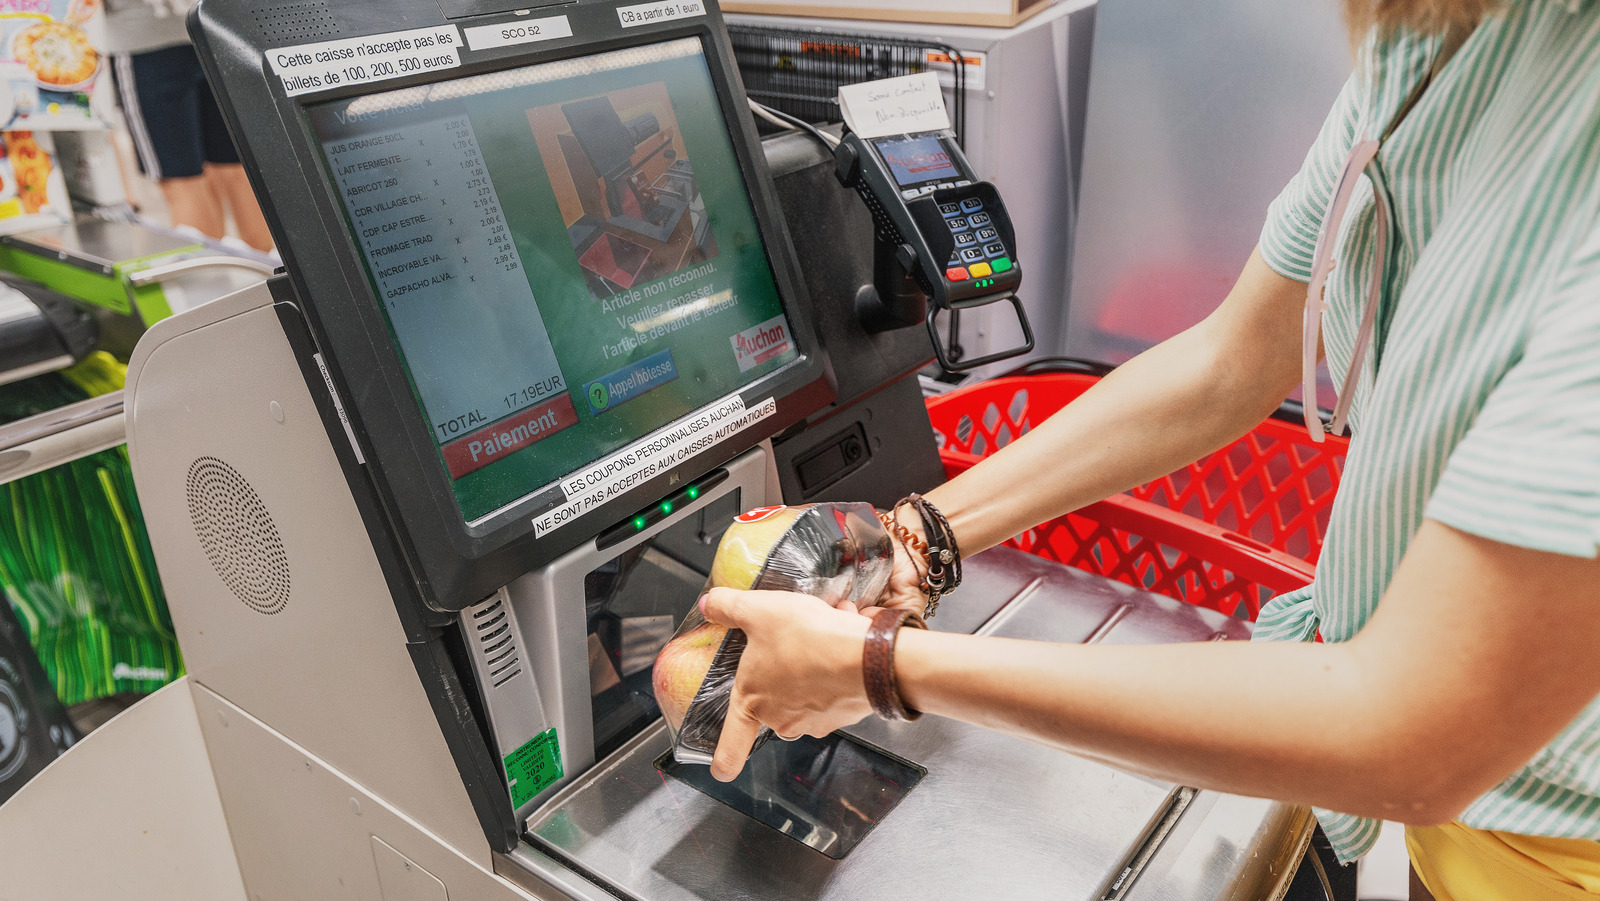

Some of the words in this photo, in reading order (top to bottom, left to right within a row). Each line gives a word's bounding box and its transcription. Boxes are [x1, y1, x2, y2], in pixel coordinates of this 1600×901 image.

[621, 11, 634, 23] CB
[635, 13, 642, 21] a
[643, 8, 663, 21] partir
[664, 6, 674, 18] de
[682, 3, 700, 14] euro
[502, 28, 526, 41] SCO
[528, 25, 541, 37] 52
[277, 49, 312, 69] Cette
[315, 45, 354, 63] caisse
[356, 38, 411, 60] n'accepte
[414, 38, 433, 53] pas
[436, 32, 453, 46] les
[284, 73, 321, 92] billets
[324, 70, 340, 85] de
[343, 65, 370, 84] 100,
[371, 62, 398, 79] 200,
[400, 58, 421, 74] 500
[423, 54, 453, 69] euros
[331, 145, 347, 155] JUS
[349, 137, 384, 151] ORANGE
[445, 121, 460, 130] 2.00
[464, 149, 476, 157] 1.79
[338, 165, 356, 176] LAIT
[358, 155, 402, 171] FERMENTE
[452, 142, 467, 150] 1.79
[471, 168, 484, 177] 1.00
[887, 152, 948, 168] Auchan
[346, 181, 384, 196] ABRICOT
[459, 161, 474, 169] 1.00
[477, 188, 490, 196] 2.73
[355, 205, 374, 217] CDR
[374, 197, 407, 212] VILLAGE
[466, 180, 481, 189] 2.73
[484, 206, 497, 215] 2.19
[943, 205, 950, 213] 2
[363, 225, 380, 238] CDP
[381, 221, 398, 233] CAP
[473, 199, 489, 208] 2.19
[491, 225, 504, 234] 2.00
[950, 220, 958, 228] 5
[370, 243, 410, 259] FROMAGE
[412, 234, 433, 246] TRAD
[480, 218, 496, 227] 2.00
[498, 245, 511, 253] 2.49
[958, 235, 966, 243] 8
[378, 260, 428, 278] INCROYABLE
[487, 237, 503, 246] 2.49
[505, 263, 518, 271] 2.99
[387, 279, 430, 299] GAZPACHO
[494, 255, 510, 265] 2.99
[601, 290, 642, 314] Article
[643, 283, 666, 299] non
[669, 266, 718, 290] reconnu.
[616, 303, 665, 329] Veuillez
[667, 284, 715, 313] repasser
[602, 332, 648, 360] l'article
[649, 315, 690, 341] devant
[691, 311, 702, 323] le
[704, 295, 739, 319] lecteur
[735, 323, 785, 359] Auchan
[609, 377, 636, 399] Appel
[636, 359, 672, 383] hôtesse
[438, 410, 487, 436] TOTAL
[503, 376, 563, 409] 17.19EUR
[470, 409, 557, 461] Paiement
[563, 479, 584, 496] LES
[585, 454, 636, 486] COUPONS
[634, 417, 709, 461] PERSONNALISES
[709, 399, 744, 428] AUCHAN
[535, 518, 552, 535] NE
[553, 502, 582, 527] SONT
[584, 491, 606, 510] PAS
[606, 465, 657, 499] ACCEPTES
[656, 454, 676, 474] AUX
[676, 436, 713, 462] CAISSES
[711, 401, 776, 443] AUTOMATIQUES
[516, 735, 544, 756] INSTRUMENT
[520, 753, 537, 767] LIMITE
[526, 761, 545, 780] 2020
